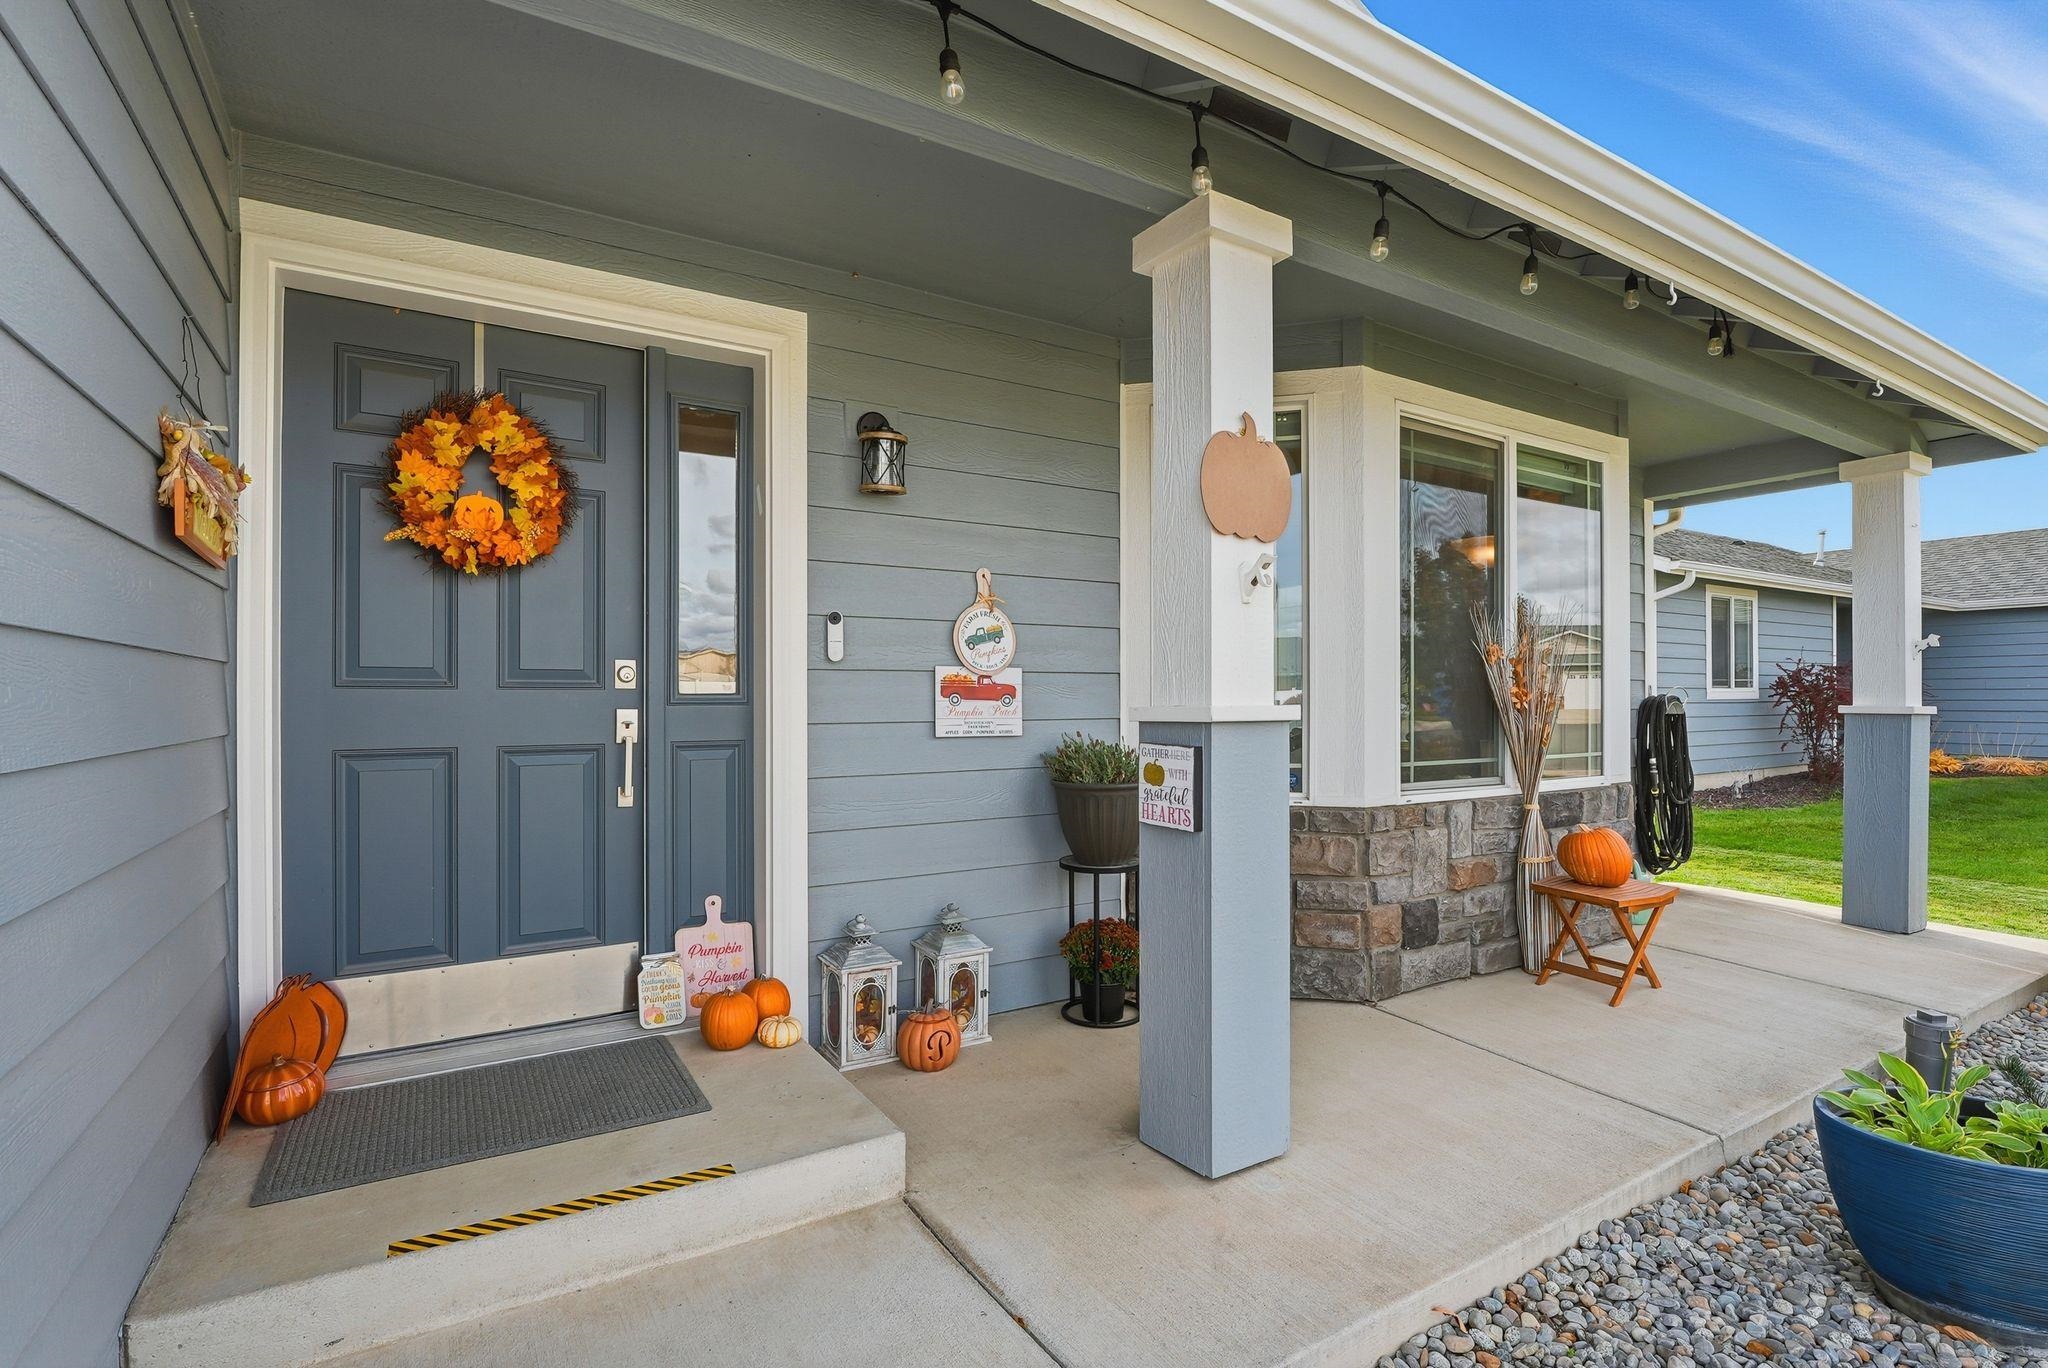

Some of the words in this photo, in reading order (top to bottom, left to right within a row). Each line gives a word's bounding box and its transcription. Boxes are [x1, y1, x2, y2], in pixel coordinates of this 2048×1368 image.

[964, 612, 979, 629] FARM
[980, 610, 1001, 622] FRESH
[946, 705, 984, 720] Pumpkin
[992, 705, 1017, 716] Patch
[1141, 747, 1169, 759] GATHER
[1169, 749, 1191, 761] HERE
[1168, 768, 1188, 780] WITH
[1143, 786, 1189, 805] grateful
[1142, 802, 1191, 827] HEARTS
[688, 941, 744, 958] Pumpkin
[698, 968, 749, 987] Harvest
[642, 993, 681, 1004] Pumpkin
[927, 1030, 951, 1061] P
